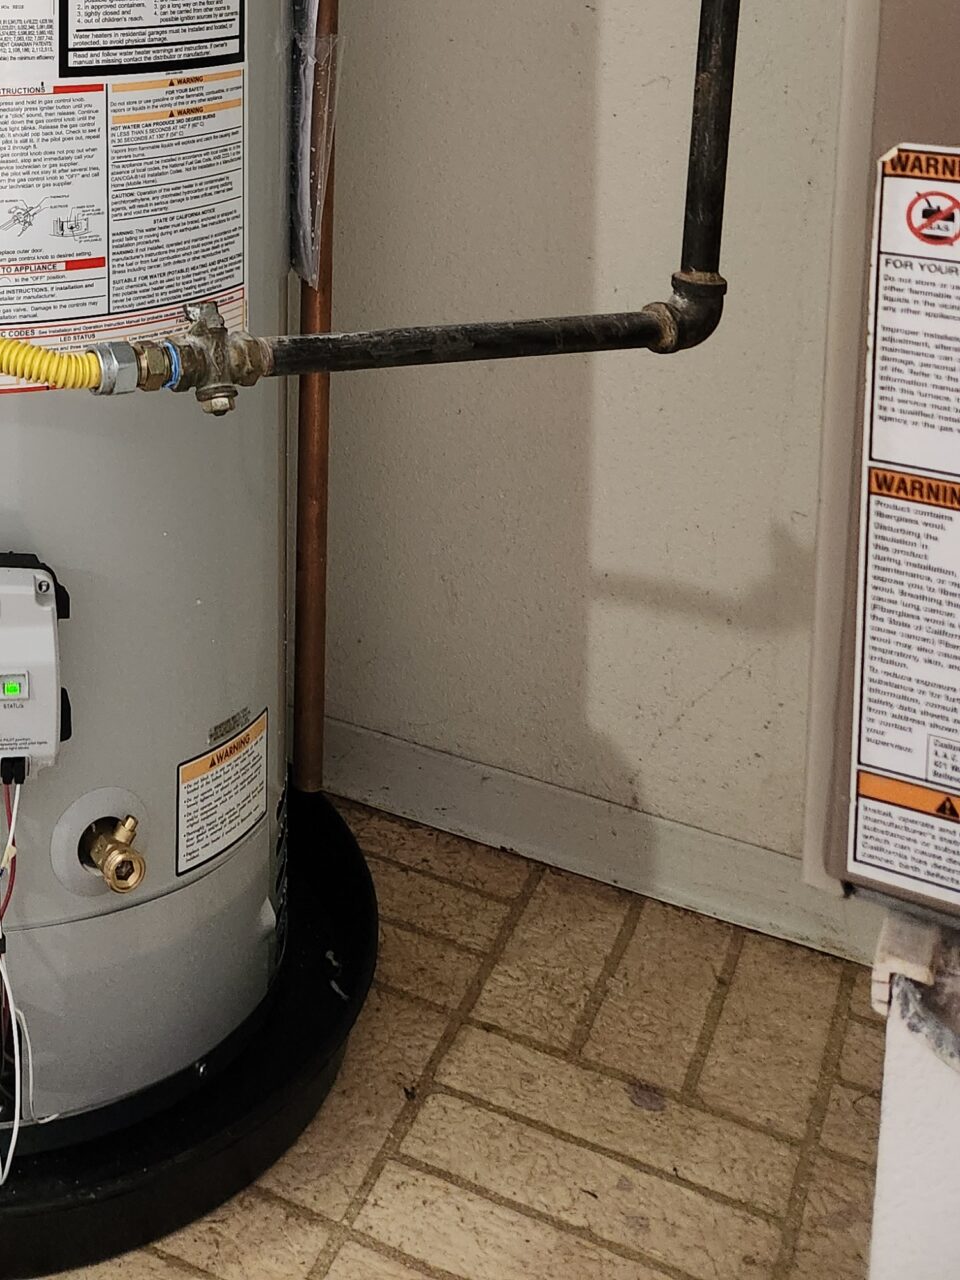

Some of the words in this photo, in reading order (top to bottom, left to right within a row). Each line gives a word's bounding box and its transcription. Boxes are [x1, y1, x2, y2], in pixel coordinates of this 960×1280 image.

[176, 75, 203, 84] WARNING
[176, 106, 204, 115] WARNING
[1, 265, 11, 273] TO
[14, 264, 56, 273] APPLIANCE
[885, 258, 913, 270] FOR
[919, 263, 960, 276] YOUR
[8, 329, 35, 337] CODES
[72, 333, 95, 342] STATUS
[215, 733, 251, 765] WARNING
